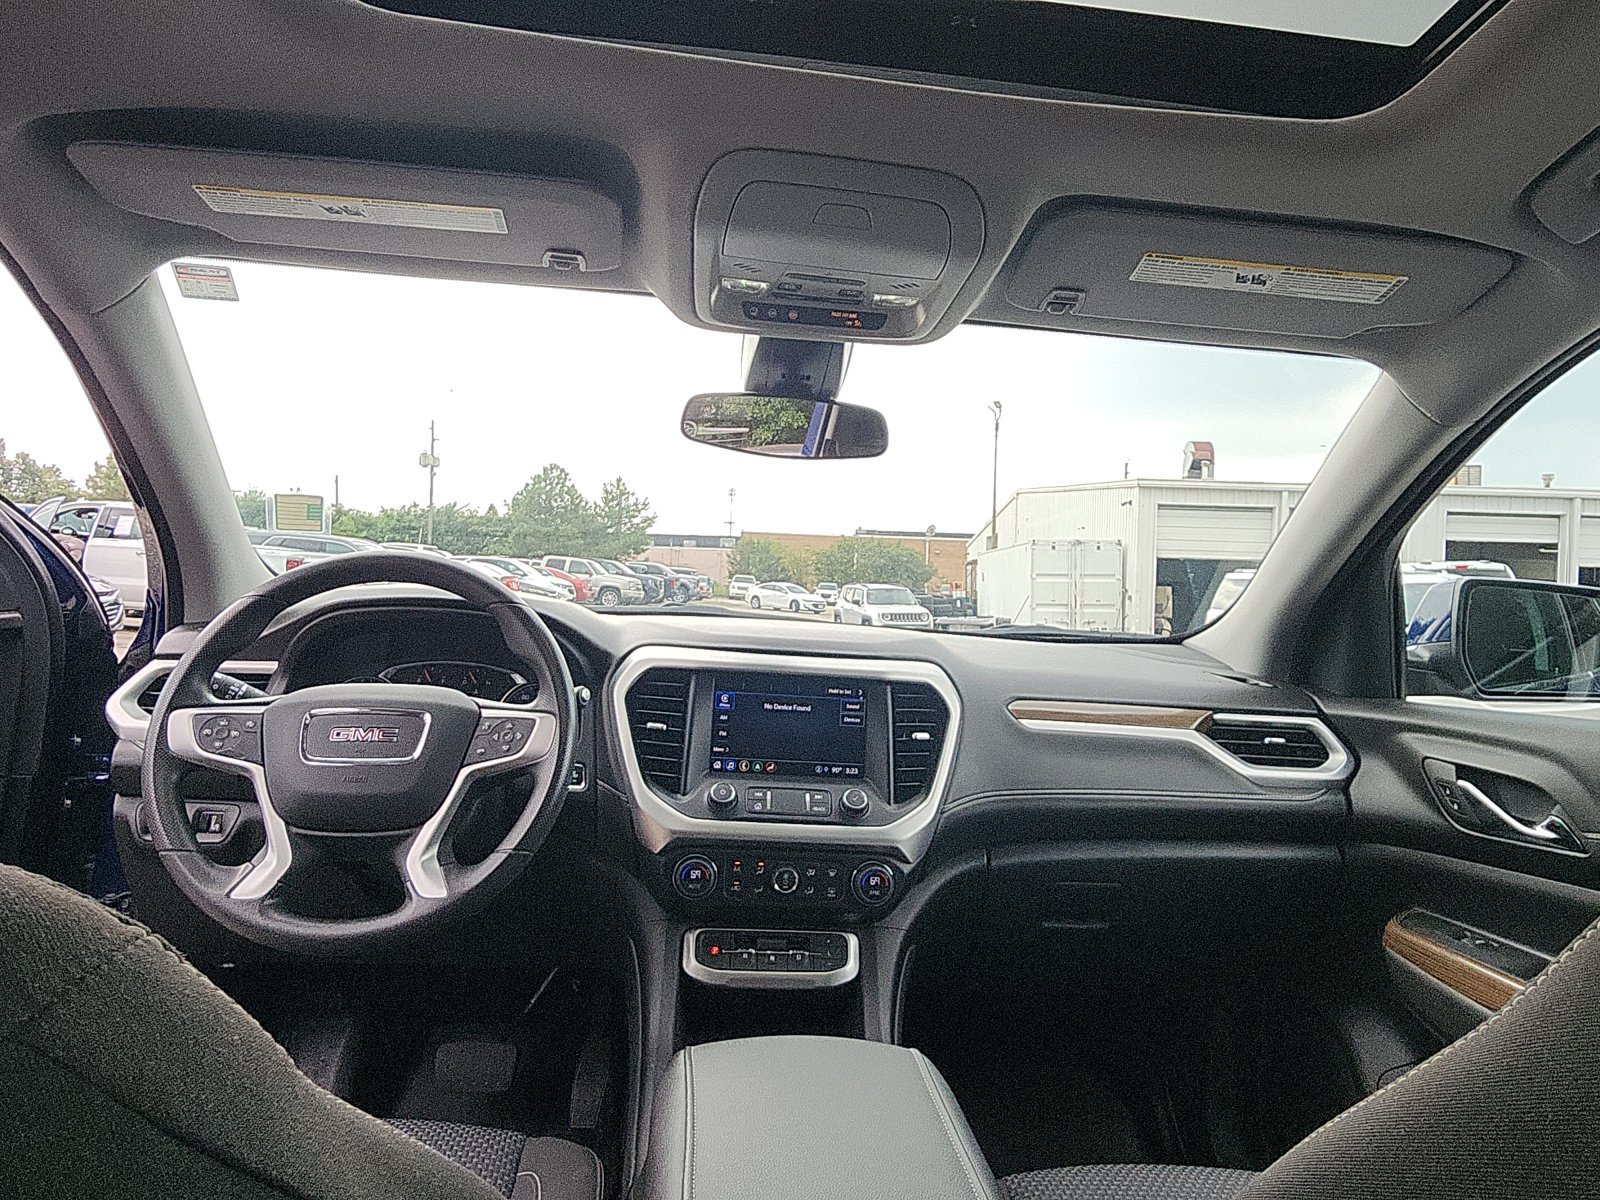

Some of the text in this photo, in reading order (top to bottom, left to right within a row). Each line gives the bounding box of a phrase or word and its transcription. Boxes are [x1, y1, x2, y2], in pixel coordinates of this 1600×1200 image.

[773, 703, 793, 711] Device
[792, 704, 812, 712] Found
[329, 726, 400, 743] GMC
[869, 876, 881, 886] 69
